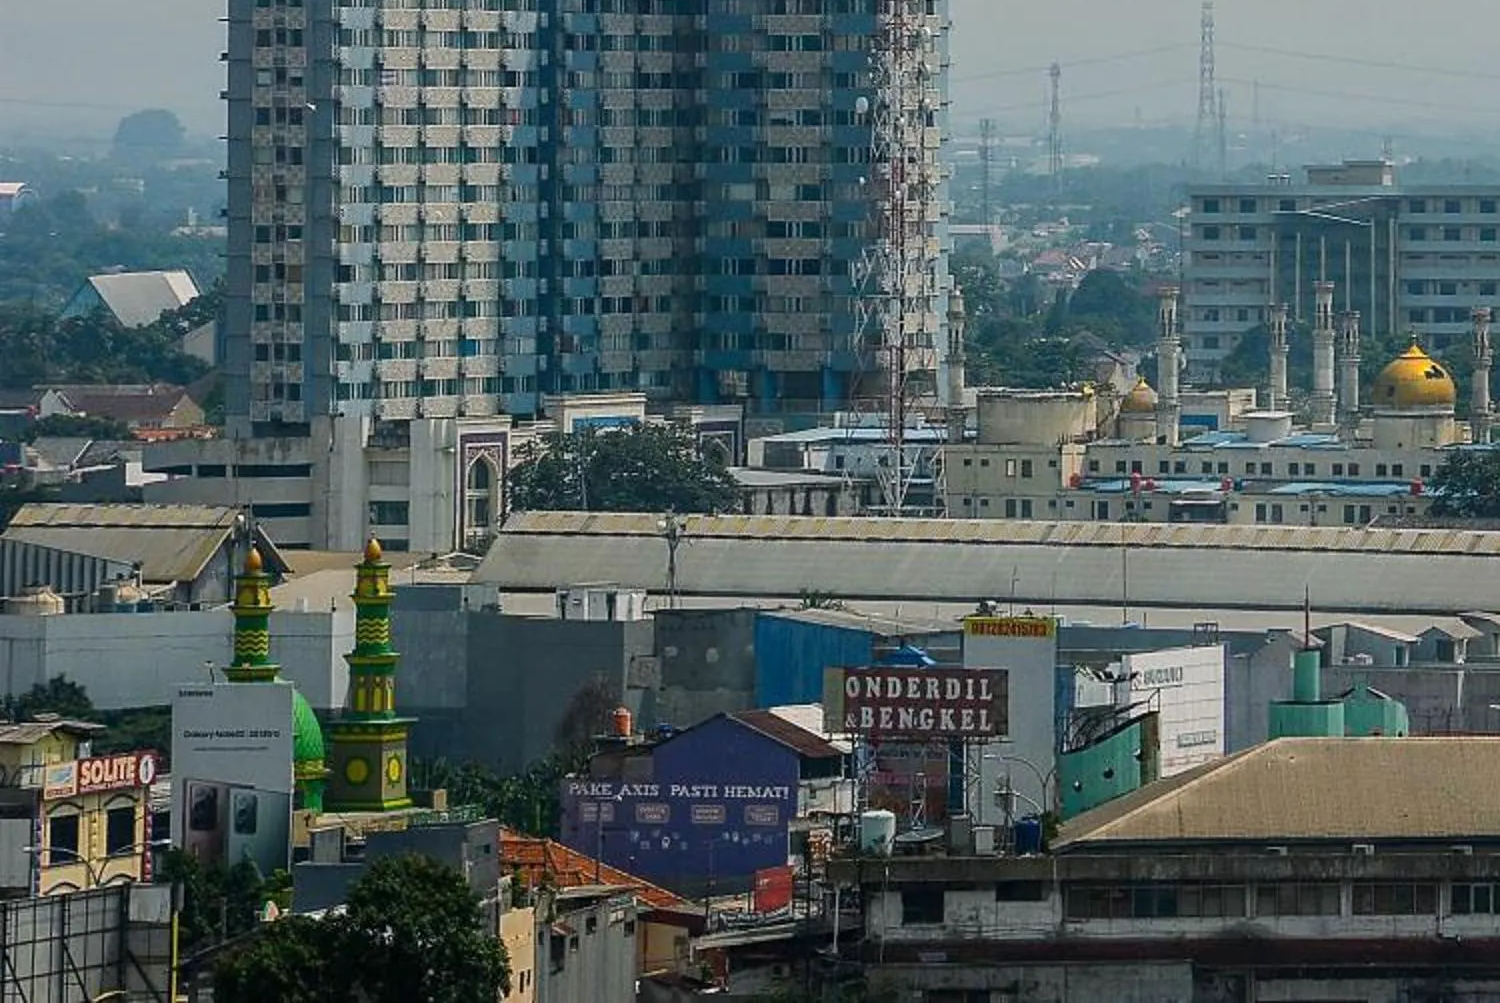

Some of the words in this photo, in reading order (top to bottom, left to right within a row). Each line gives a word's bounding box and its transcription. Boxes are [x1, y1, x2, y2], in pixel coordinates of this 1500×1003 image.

[845, 676, 993, 701] ONDERDIL
[860, 706, 992, 732] BENGKEL
[80, 756, 137, 786] SOLITE
[569, 783, 612, 796] PAKE
[619, 783, 659, 797] AXIS
[671, 784, 717, 798] PASTI
[724, 786, 789, 800] HEMAT!
